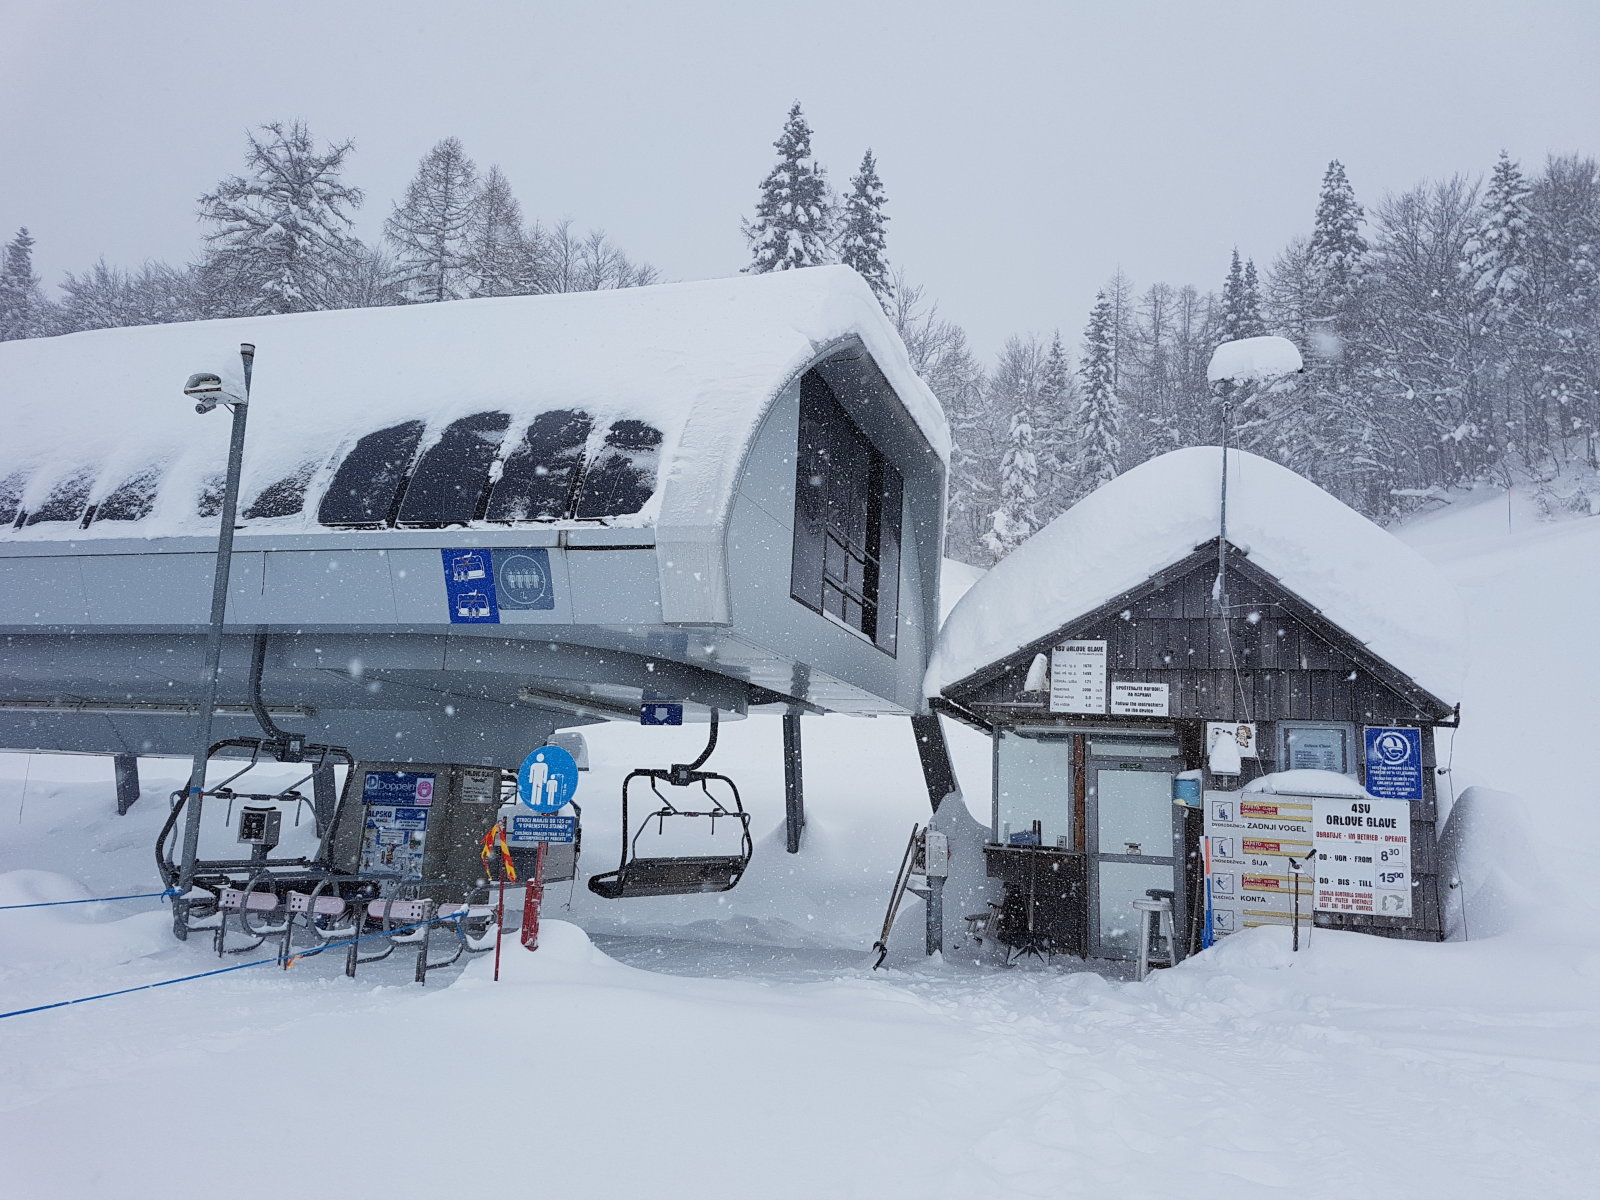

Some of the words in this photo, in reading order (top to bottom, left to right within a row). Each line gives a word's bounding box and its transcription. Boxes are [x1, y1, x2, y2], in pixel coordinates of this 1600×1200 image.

[1351, 803, 1371, 813] 4SV
[1326, 815, 1363, 827] ORLOVE
[1366, 817, 1397, 829] GLAVE
[1247, 822, 1276, 831] ZADNJI
[1278, 824, 1307, 833] VOGEL
[1316, 831, 1342, 839] OBRATUJE
[1357, 833, 1379, 841] BETRIEB
[1384, 835, 1407, 843] OPERATE
[1251, 858, 1268, 866] ŠIJA
[1319, 853, 1328, 861] OD
[1335, 854, 1347, 862] VON
[1354, 855, 1372, 863] FROM
[1338, 878, 1350, 886] BIS
[1359, 879, 1373, 888] TILL
[1240, 895, 1266, 903] KONTA
